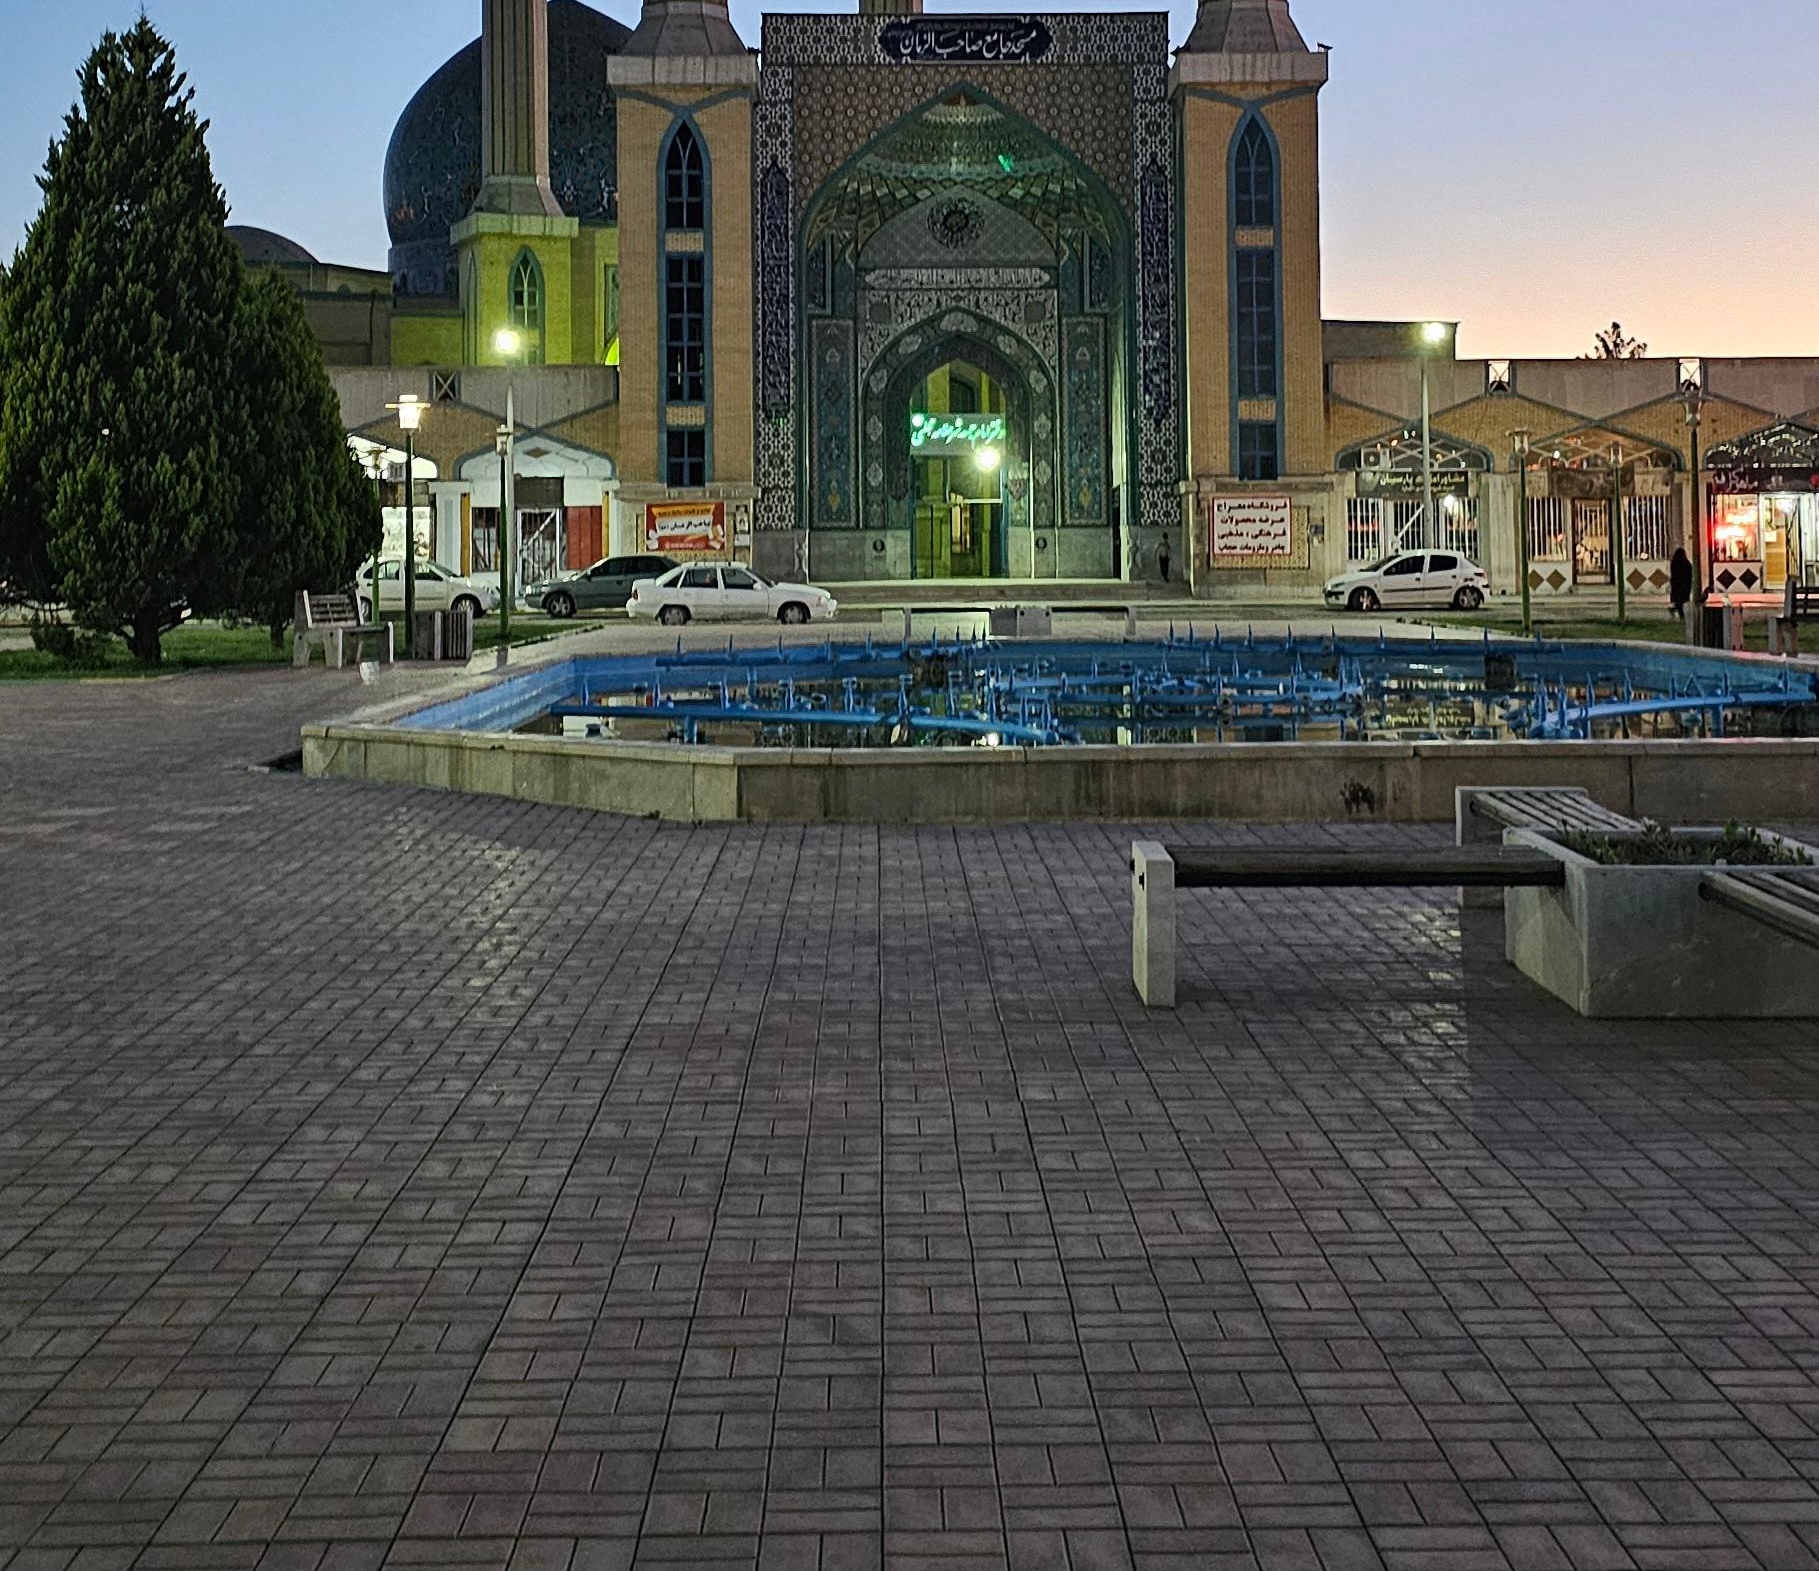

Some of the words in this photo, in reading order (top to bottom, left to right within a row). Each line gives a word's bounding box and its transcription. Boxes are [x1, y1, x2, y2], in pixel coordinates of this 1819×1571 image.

[899, 30, 935, 55] الزمان
[934, 30, 983, 59] صاحب
[983, 31, 1012, 60] جامع
[1010, 29, 1037, 54] مسجد
[1217, 501, 1246, 513] معراج
[1247, 501, 1288, 512] فروشگاه
[1220, 515, 1257, 526] محصولات
[1258, 515, 1285, 526] عرضه
[1217, 528, 1244, 540] مذهبی
[1251, 528, 1287, 540] فرهنگی
